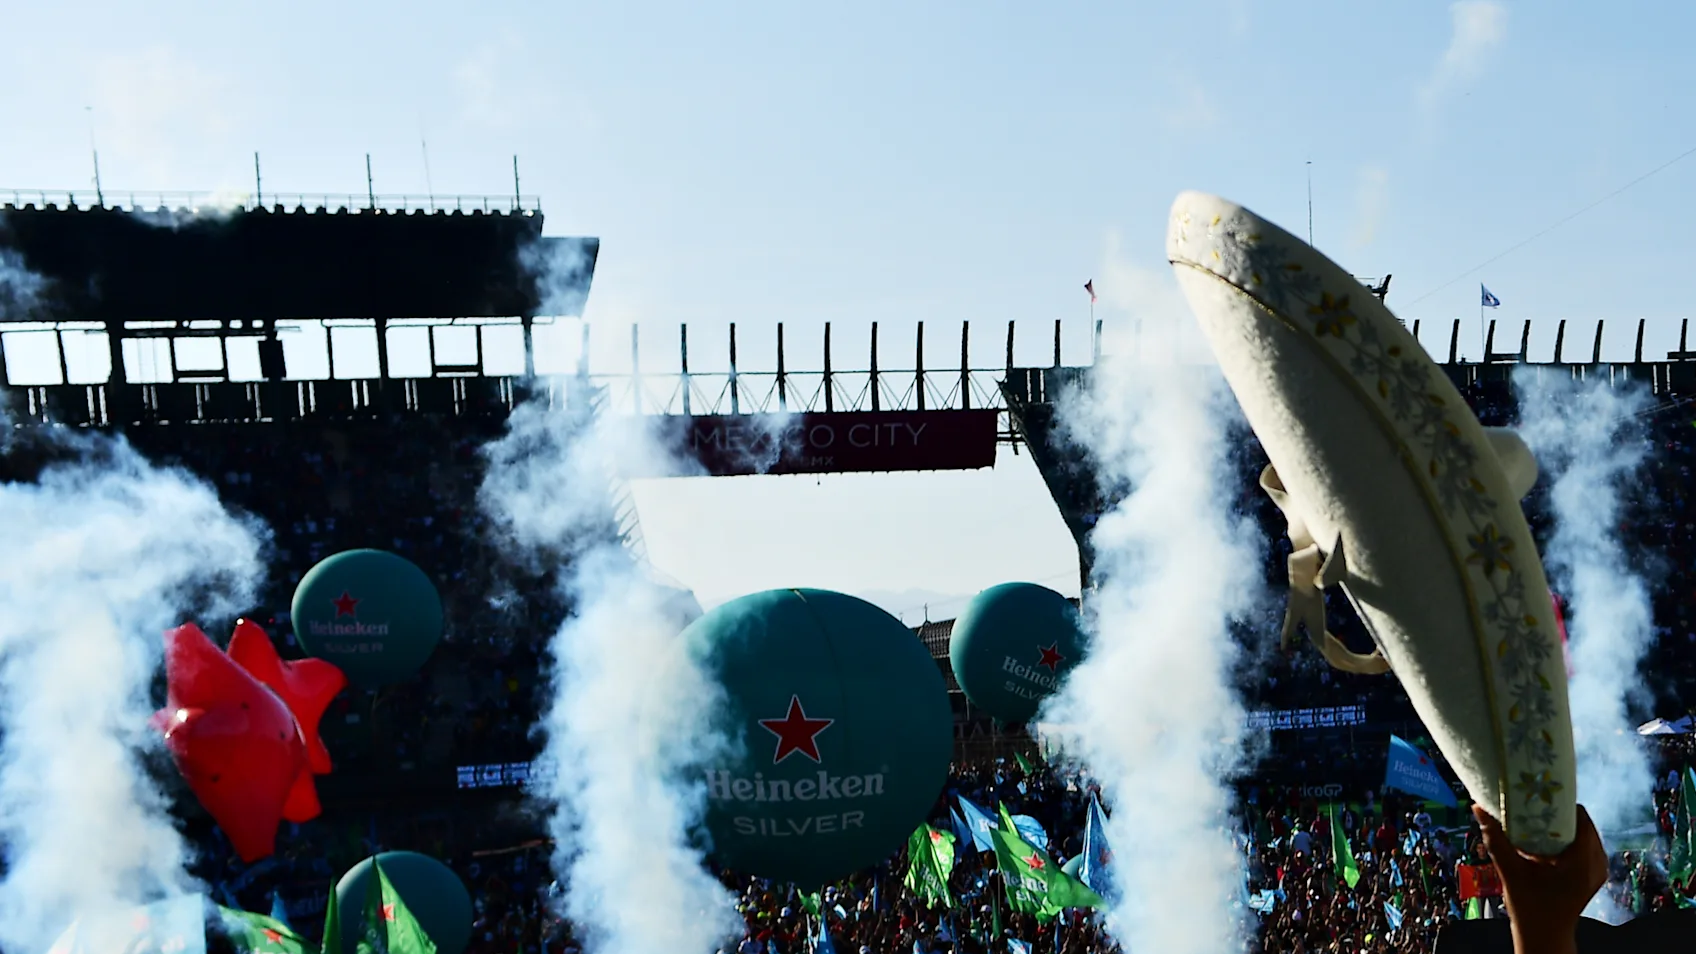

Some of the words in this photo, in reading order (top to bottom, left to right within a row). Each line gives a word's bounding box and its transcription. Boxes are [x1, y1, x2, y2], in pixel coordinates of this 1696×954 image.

[693, 424, 835, 450] MEXCO
[849, 422, 927, 448] CITY
[309, 620, 389, 636] Heineken
[1002, 656, 1061, 693] Heinek
[1004, 680, 1046, 701] SILV
[704, 769, 885, 802] Heineken
[733, 810, 866, 837] SILVER
